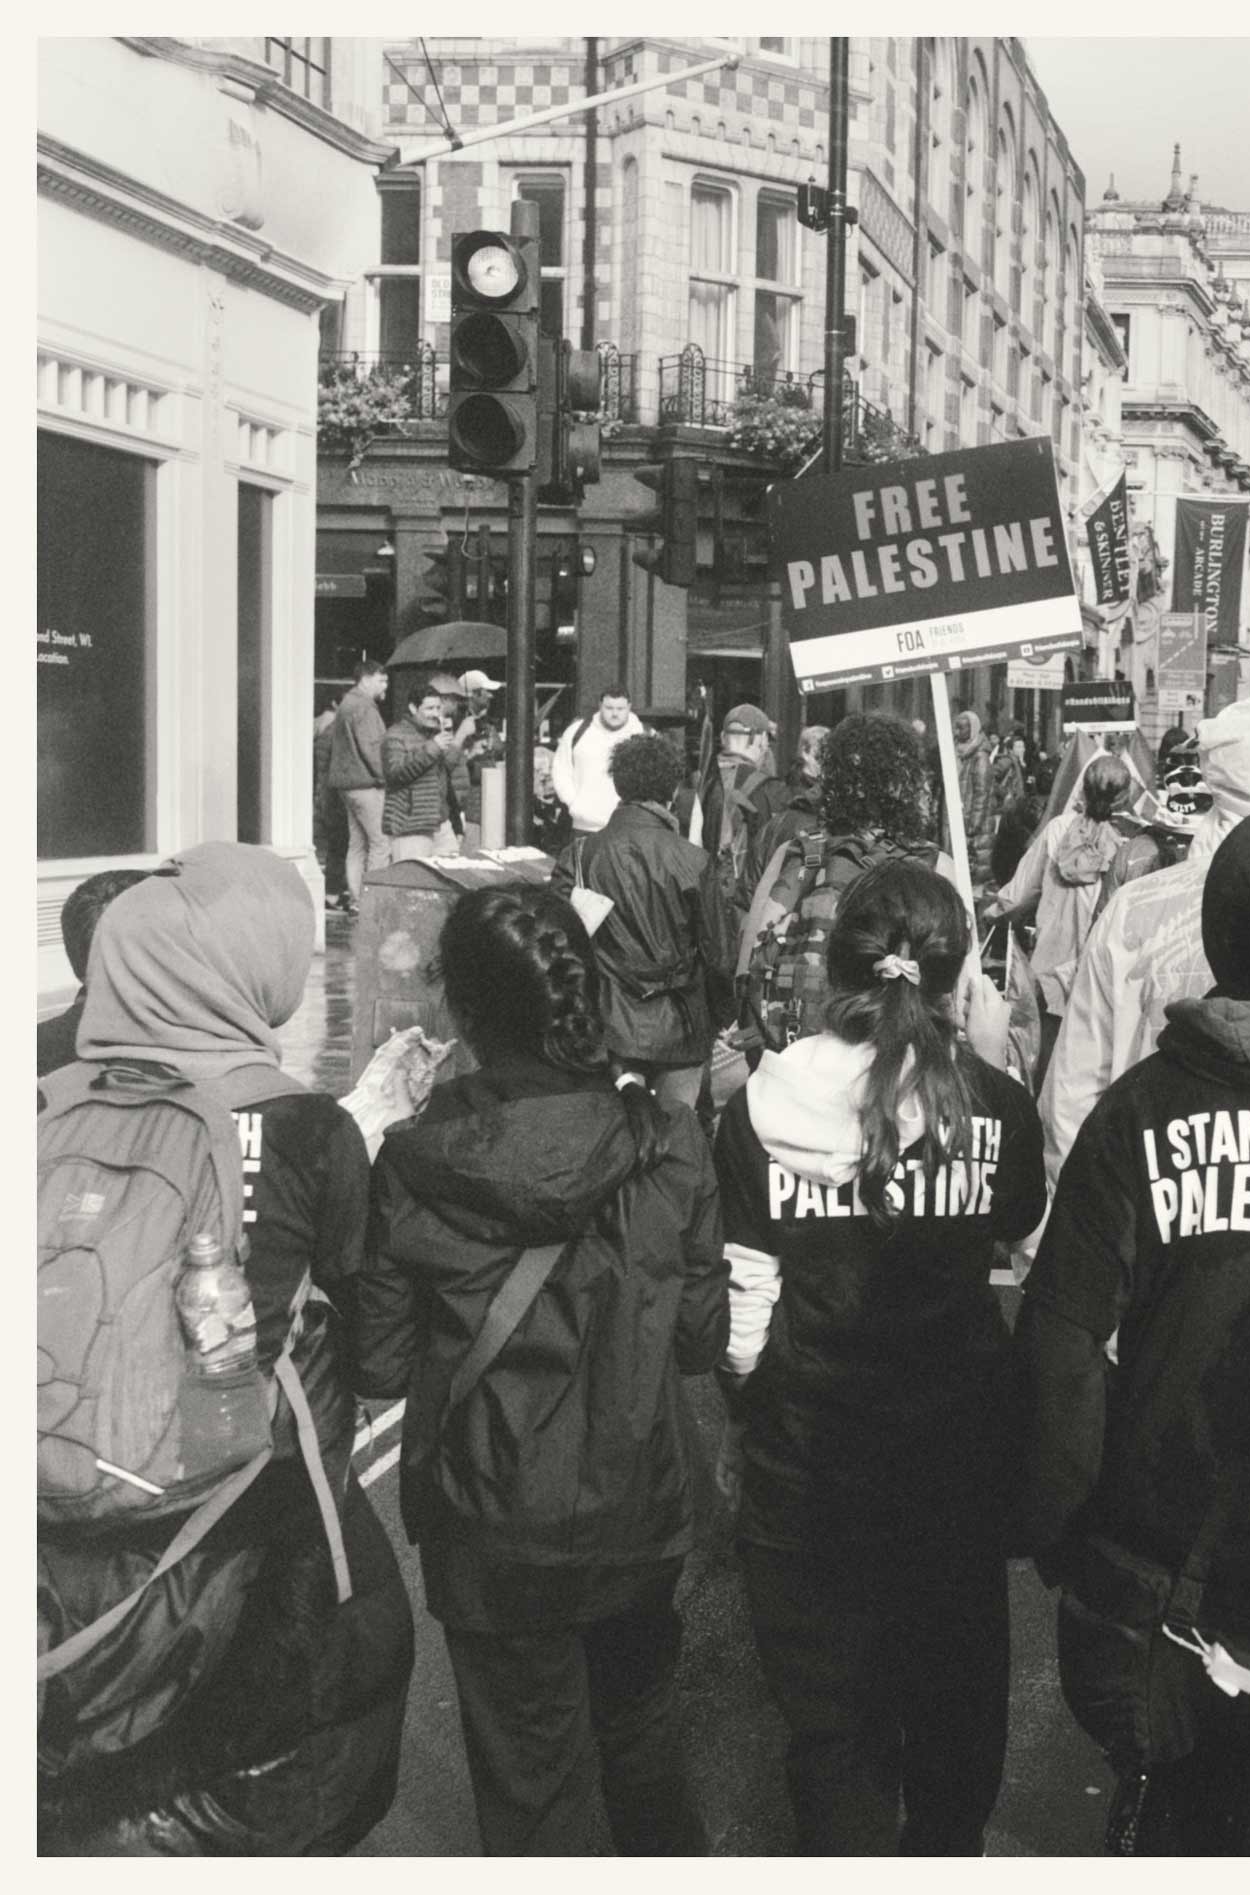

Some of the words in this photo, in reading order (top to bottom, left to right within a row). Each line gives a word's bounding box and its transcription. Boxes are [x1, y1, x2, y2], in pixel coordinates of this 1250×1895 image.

[853, 473, 971, 541] FREE
[787, 516, 1058, 610] PALESTINE
[1192, 546, 1205, 597] ARCADE
[1205, 513, 1226, 633] BURLINGTON
[896, 629, 925, 653] FOA
[928, 622, 965, 638] FRIENDS
[1143, 1128, 1160, 1181] I
